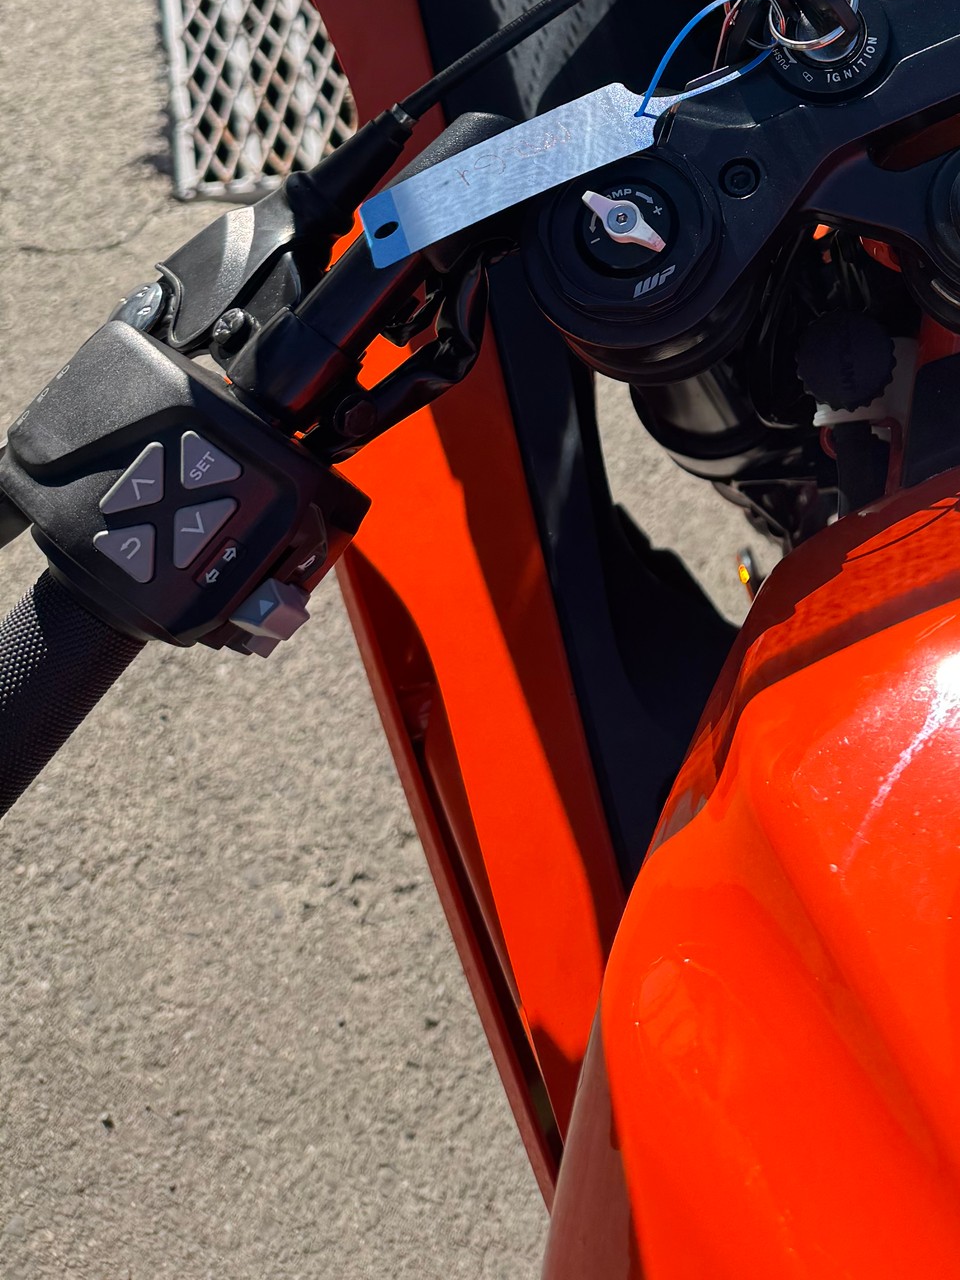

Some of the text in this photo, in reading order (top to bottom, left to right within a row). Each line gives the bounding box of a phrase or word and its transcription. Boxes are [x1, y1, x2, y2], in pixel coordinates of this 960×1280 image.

[772, 48, 790, 70] PUSH
[826, 36, 878, 83] IGNITION
[632, 264, 676, 298] WP
[189, 451, 215, 481] SET
